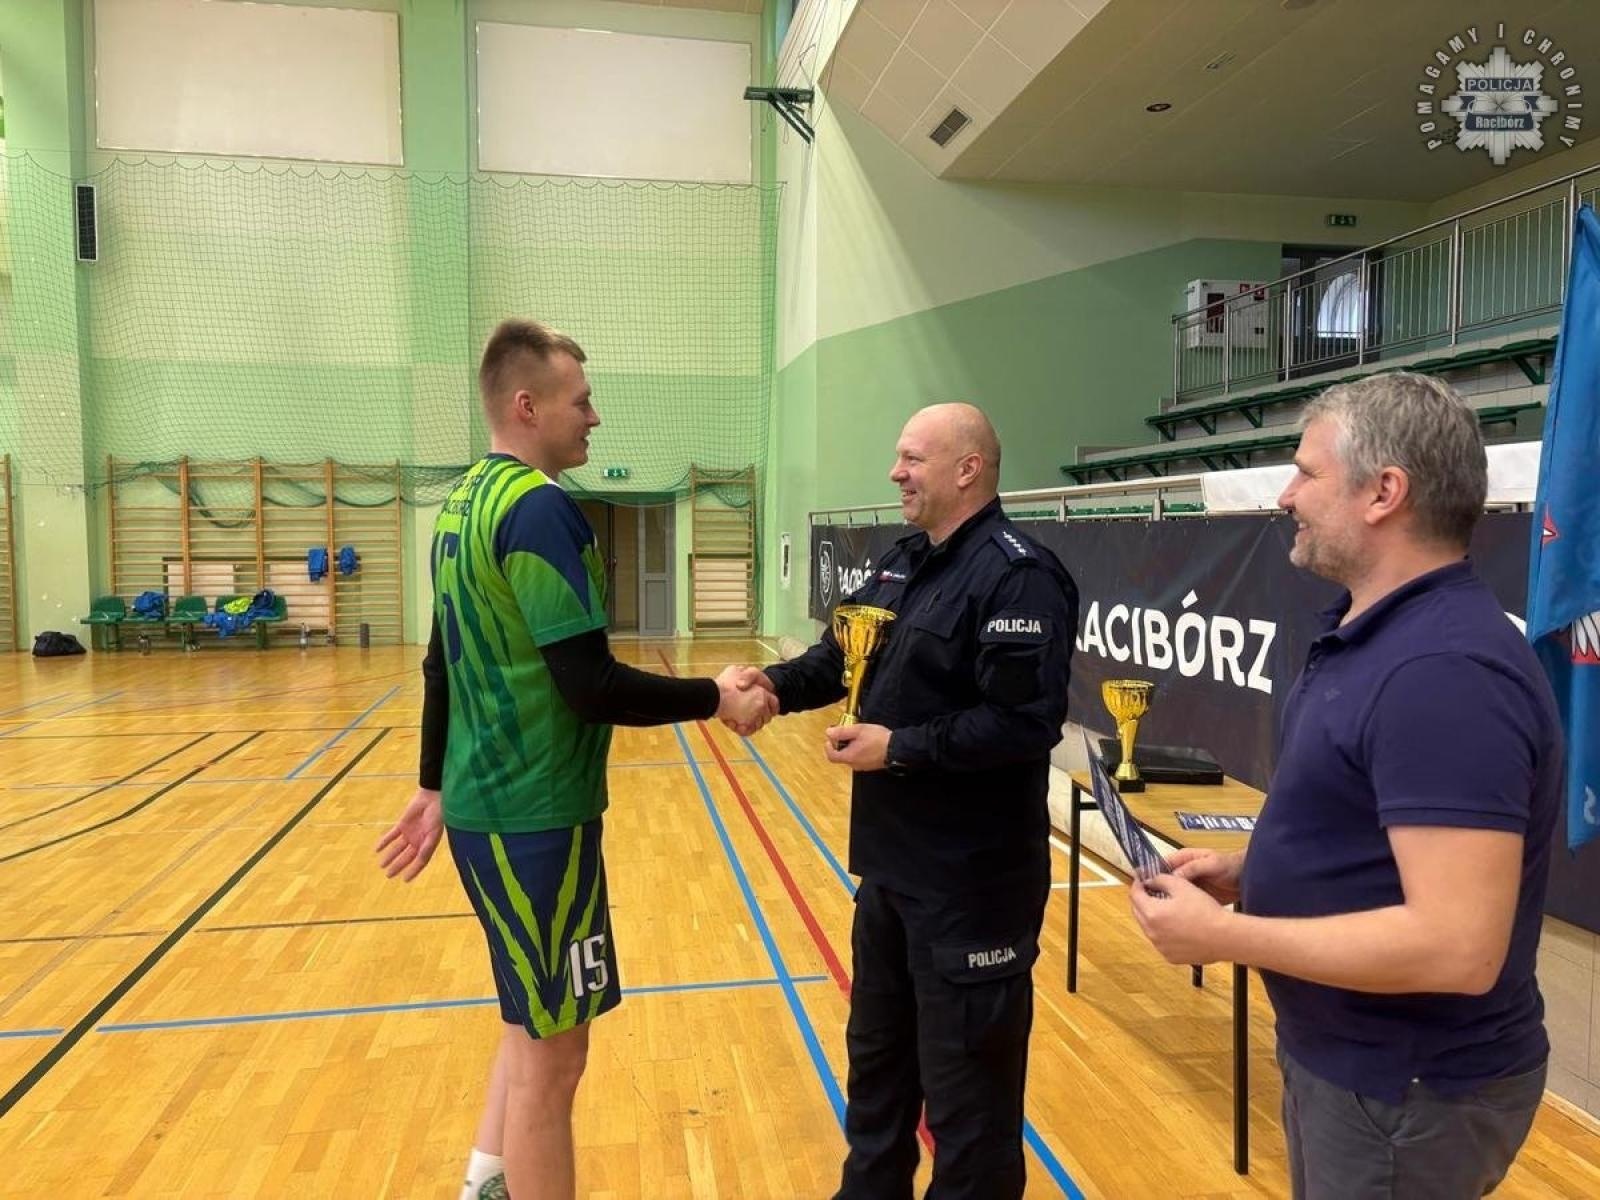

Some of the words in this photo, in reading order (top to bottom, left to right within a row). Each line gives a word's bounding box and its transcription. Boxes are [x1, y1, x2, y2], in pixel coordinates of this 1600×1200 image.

[987, 618, 1042, 634] POLICJA
[1076, 589, 1276, 694] ACIBÓRZ
[569, 933, 609, 997] 15
[968, 946, 1017, 969] POLICJA
